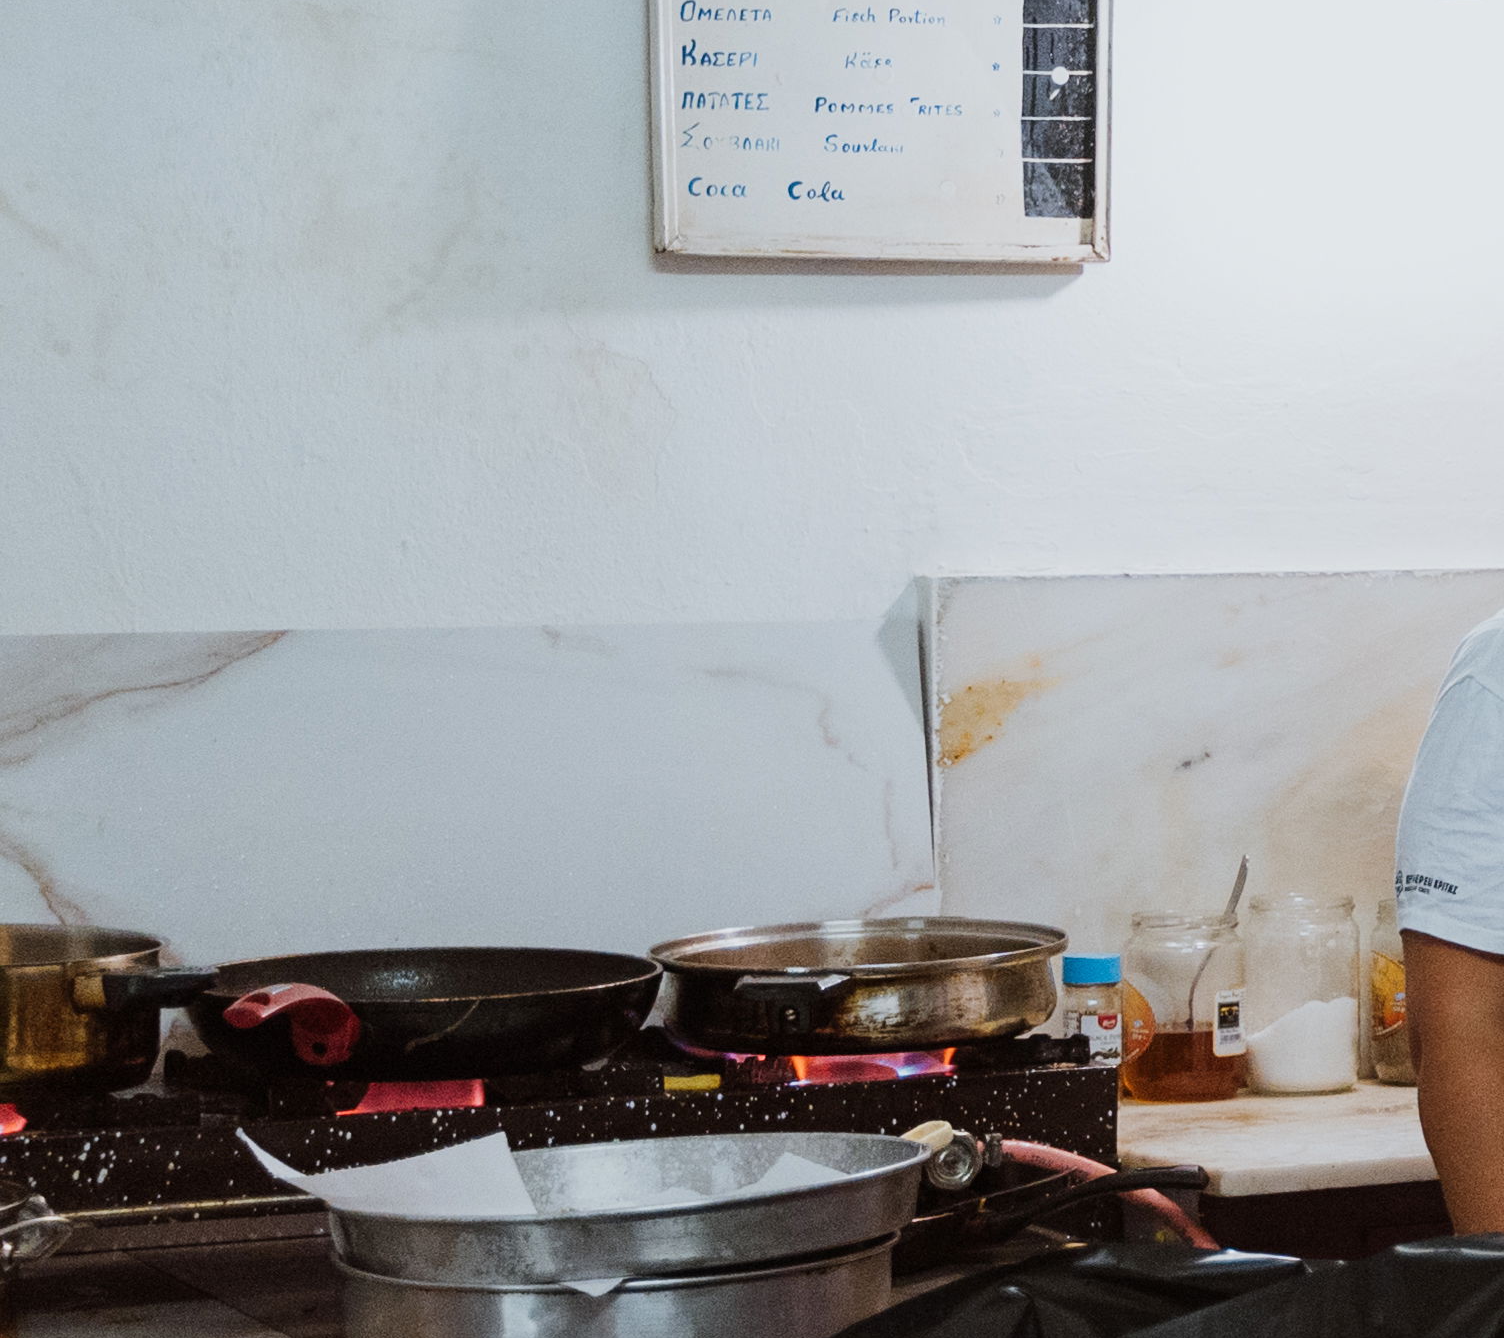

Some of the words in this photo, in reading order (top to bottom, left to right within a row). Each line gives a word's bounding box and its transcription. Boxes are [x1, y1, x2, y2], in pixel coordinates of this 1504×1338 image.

[888, 8, 947, 26] Portion
[681, 91, 770, 110] ΠΑΤΑΤΕΣ
[688, 176, 748, 199] Coca
[787, 180, 846, 202] Cola
